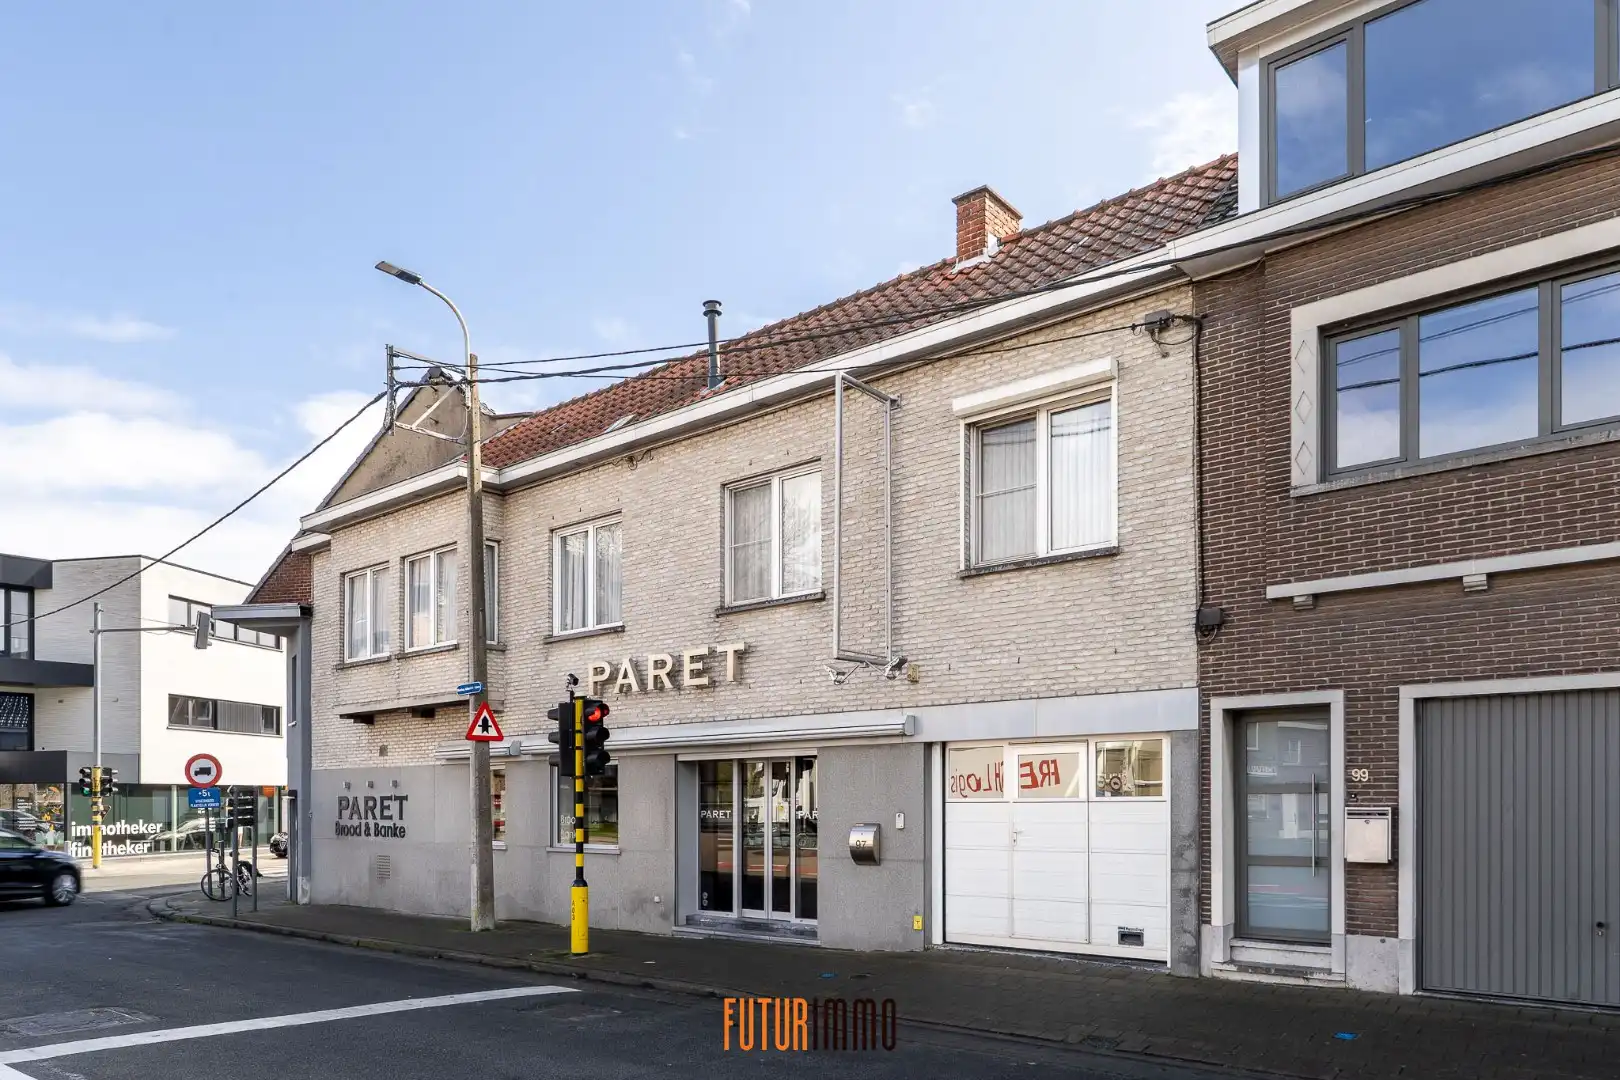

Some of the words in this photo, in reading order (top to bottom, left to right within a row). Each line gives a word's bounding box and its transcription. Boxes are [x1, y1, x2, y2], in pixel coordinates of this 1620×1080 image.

[587, 641, 747, 697] PARET
[1351, 768, 1369, 782] 99
[337, 794, 408, 820] PARET
[700, 810, 731, 819] PARET
[560, 814, 577, 825] Broo
[335, 820, 362, 837] Brood
[364, 821, 371, 837] &
[374, 821, 406, 838] Banke
[70, 839, 151, 858] fintheker
[855, 839, 867, 849] 97
